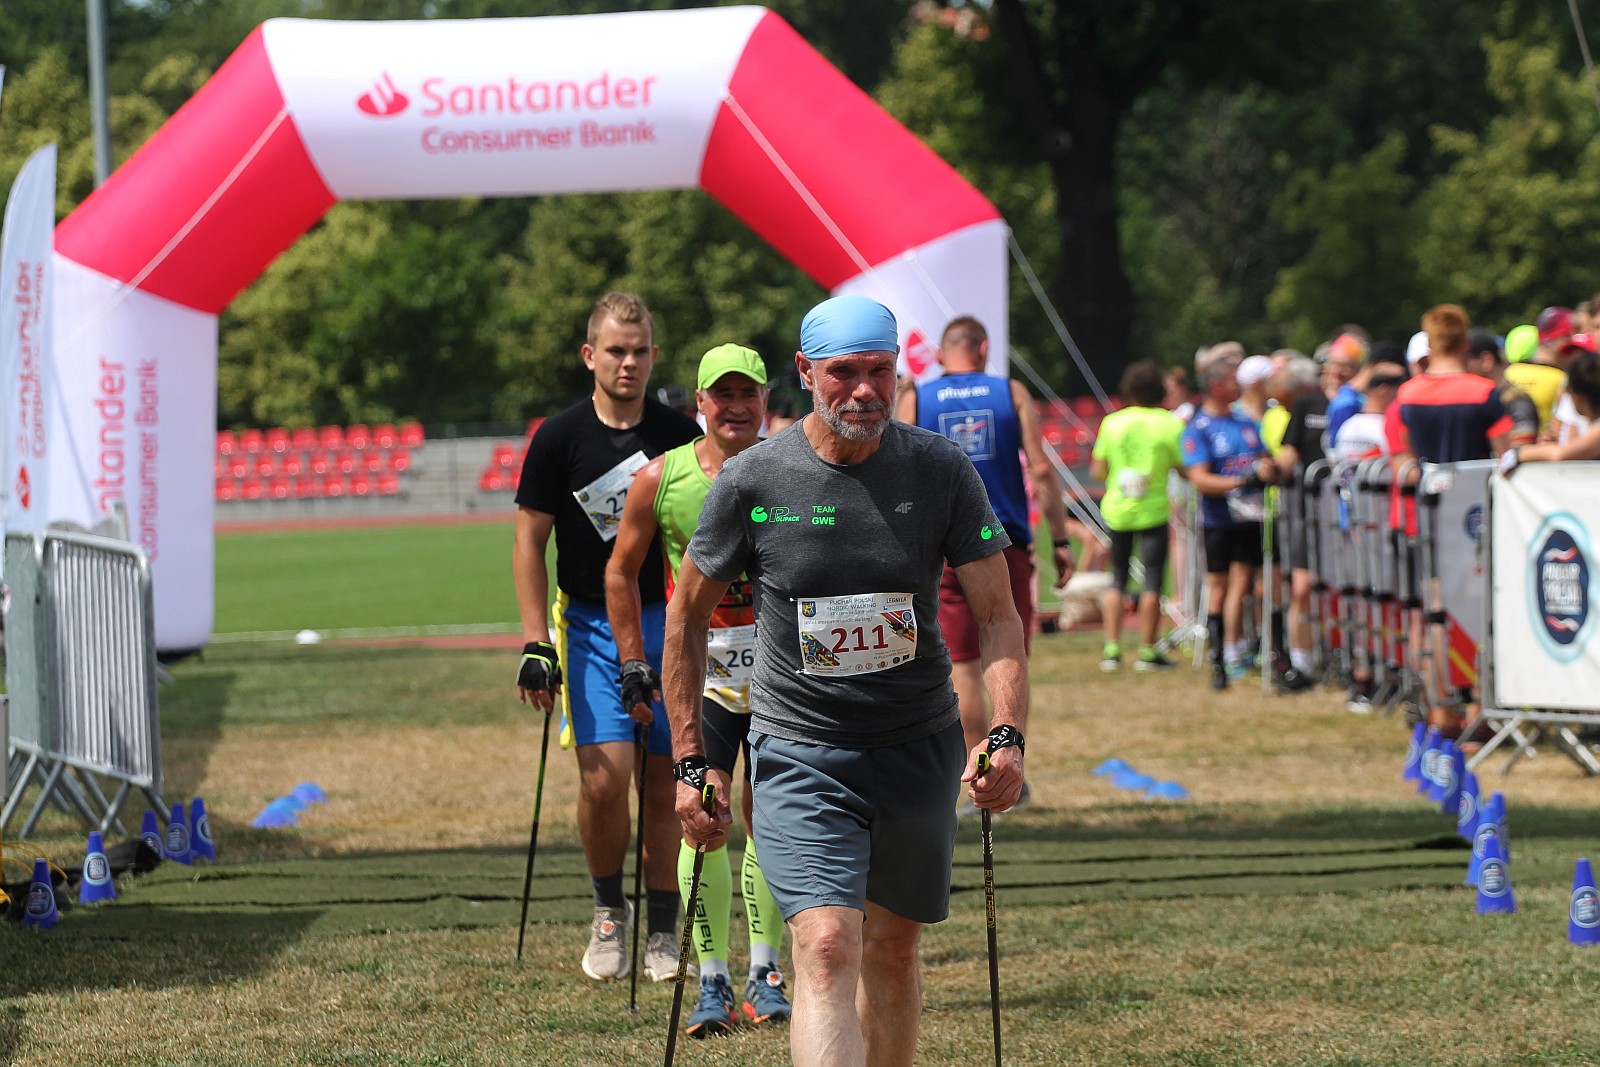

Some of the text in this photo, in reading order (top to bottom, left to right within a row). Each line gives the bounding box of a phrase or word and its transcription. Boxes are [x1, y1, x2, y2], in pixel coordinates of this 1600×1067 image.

[420, 72, 658, 117] Santander
[420, 120, 657, 154] Consumer Bank
[133, 357, 160, 427] Bank
[93, 355, 126, 513] ntander
[811, 505, 836, 513] TEAM
[811, 516, 836, 526] GWE
[850, 602, 877, 610] WALKING
[830, 624, 889, 654] 211
[725, 648, 755, 668] 26
[992, 726, 1010, 745] LEKI
[684, 761, 700, 783] LEKI
[682, 916, 695, 944] ELITE
[676, 945, 690, 984] CARBON
